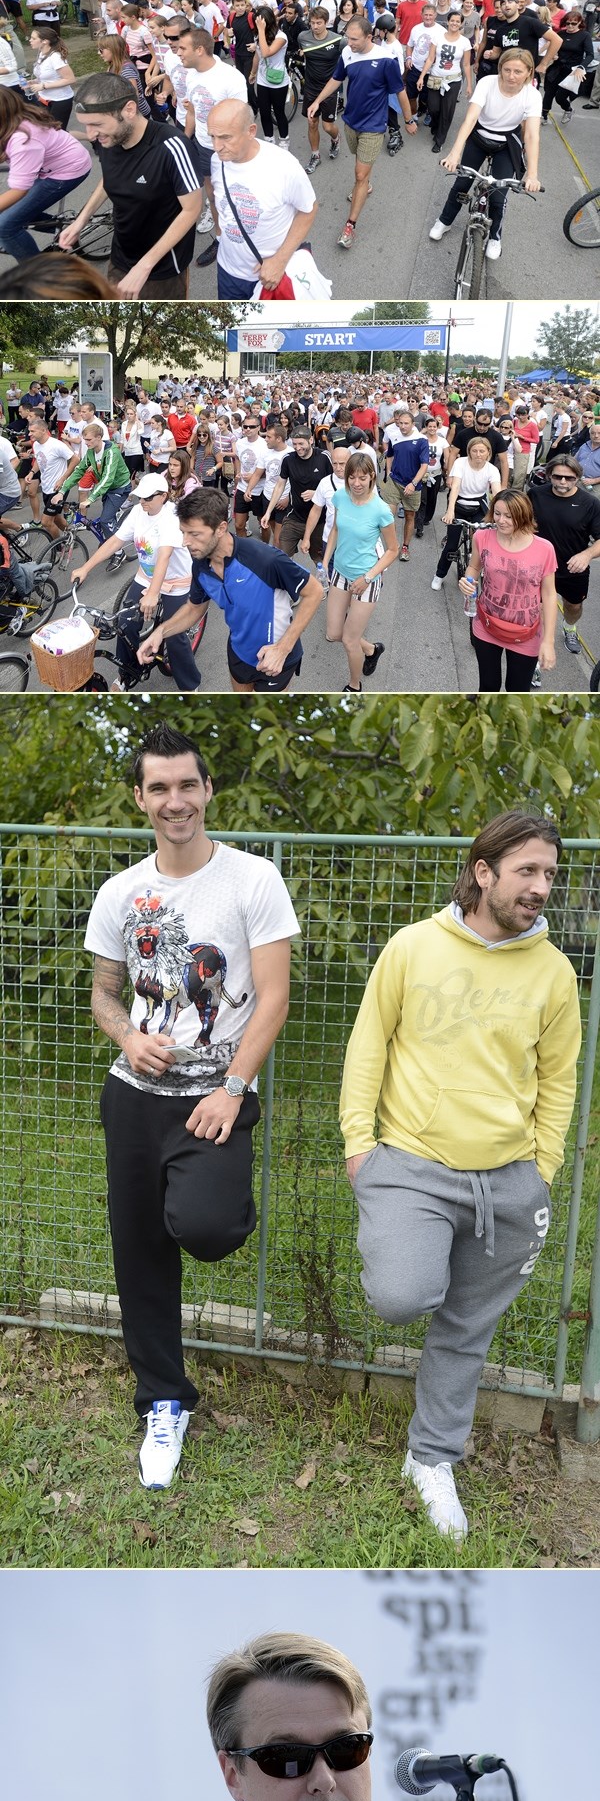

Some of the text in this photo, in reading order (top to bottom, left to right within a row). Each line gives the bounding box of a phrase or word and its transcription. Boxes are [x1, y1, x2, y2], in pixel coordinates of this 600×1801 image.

[441, 44, 456, 54] SU
[242, 334, 268, 342] TERRY
[304, 333, 356, 346] START
[247, 339, 263, 347] FOX
